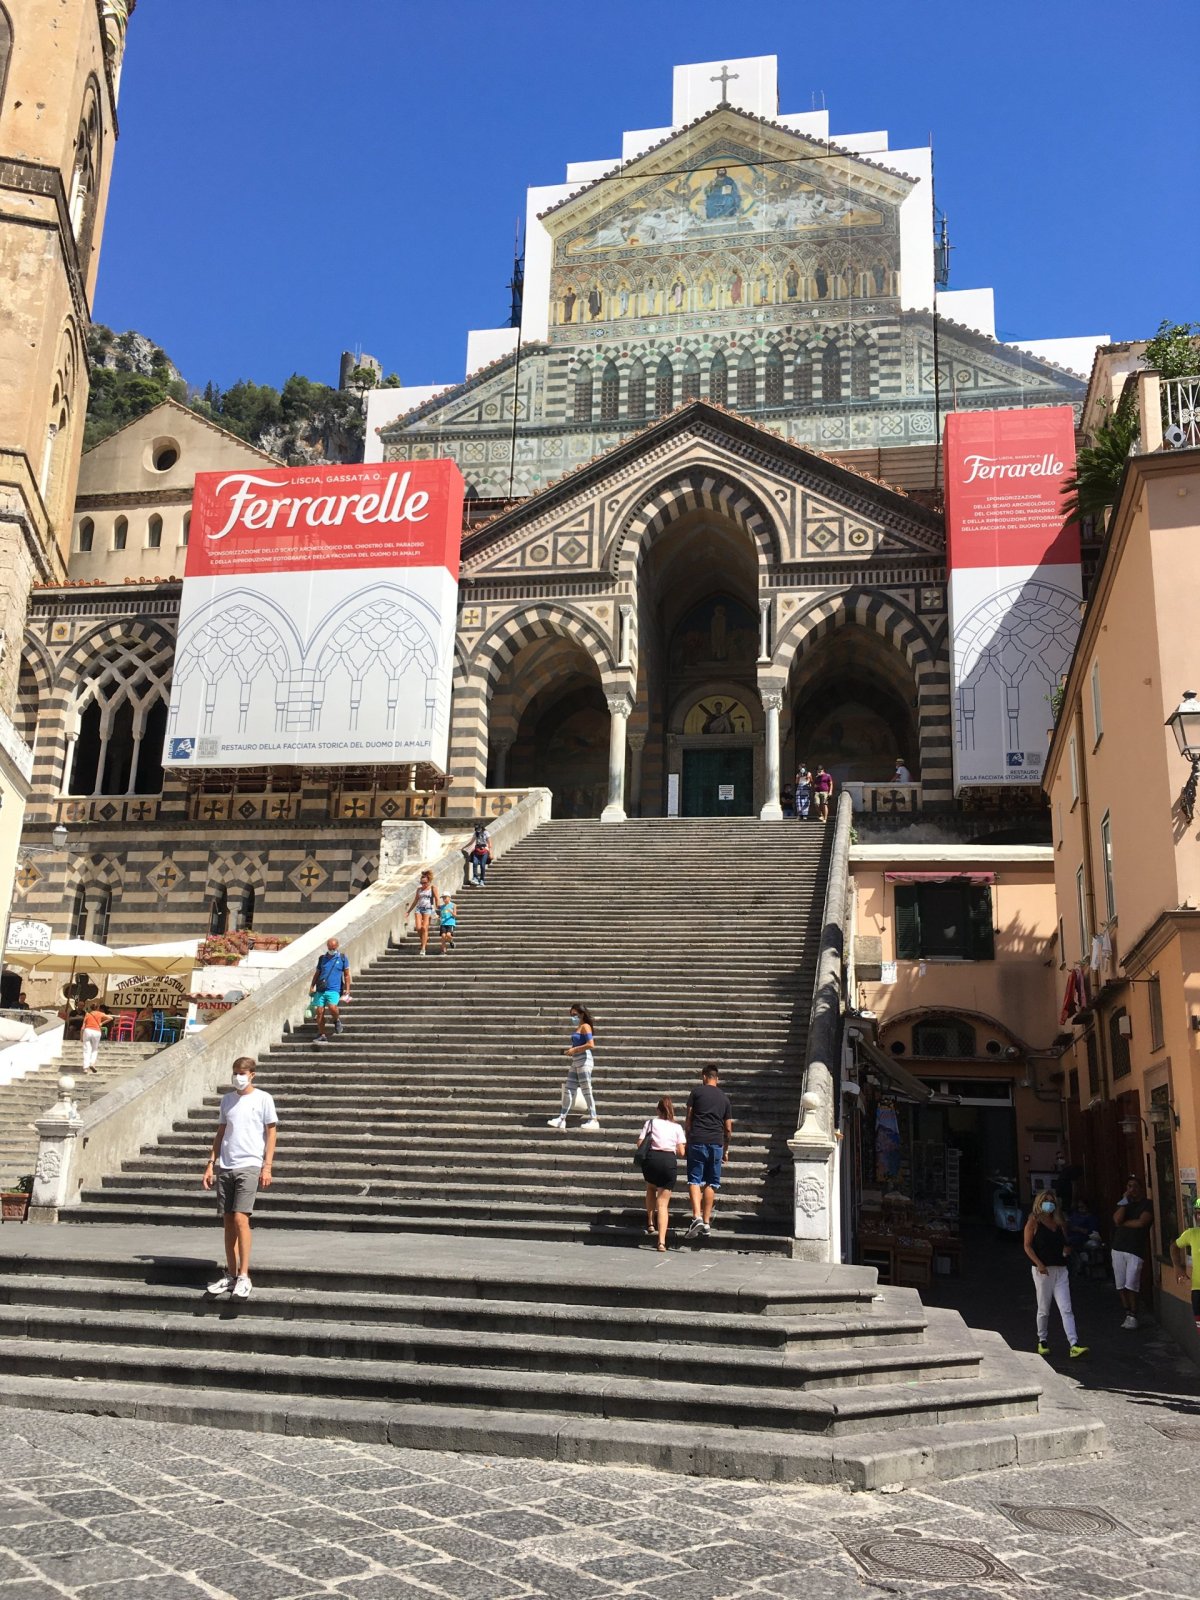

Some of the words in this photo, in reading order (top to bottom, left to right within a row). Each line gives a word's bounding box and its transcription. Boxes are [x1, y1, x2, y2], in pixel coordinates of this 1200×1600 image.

[962, 453, 1064, 484] Ferrarelle
[291, 476, 323, 485] LISCIA,
[326, 473, 370, 483] GASSATA
[207, 471, 430, 540] Ferrarelle
[283, 742, 316, 750] FACCIATA
[9, 939, 50, 948] CHIOSTRO
[116, 976, 148, 991] TAVERNA
[156, 976, 186, 993] APOSTOLI
[113, 993, 182, 1006] RISTORANTE
